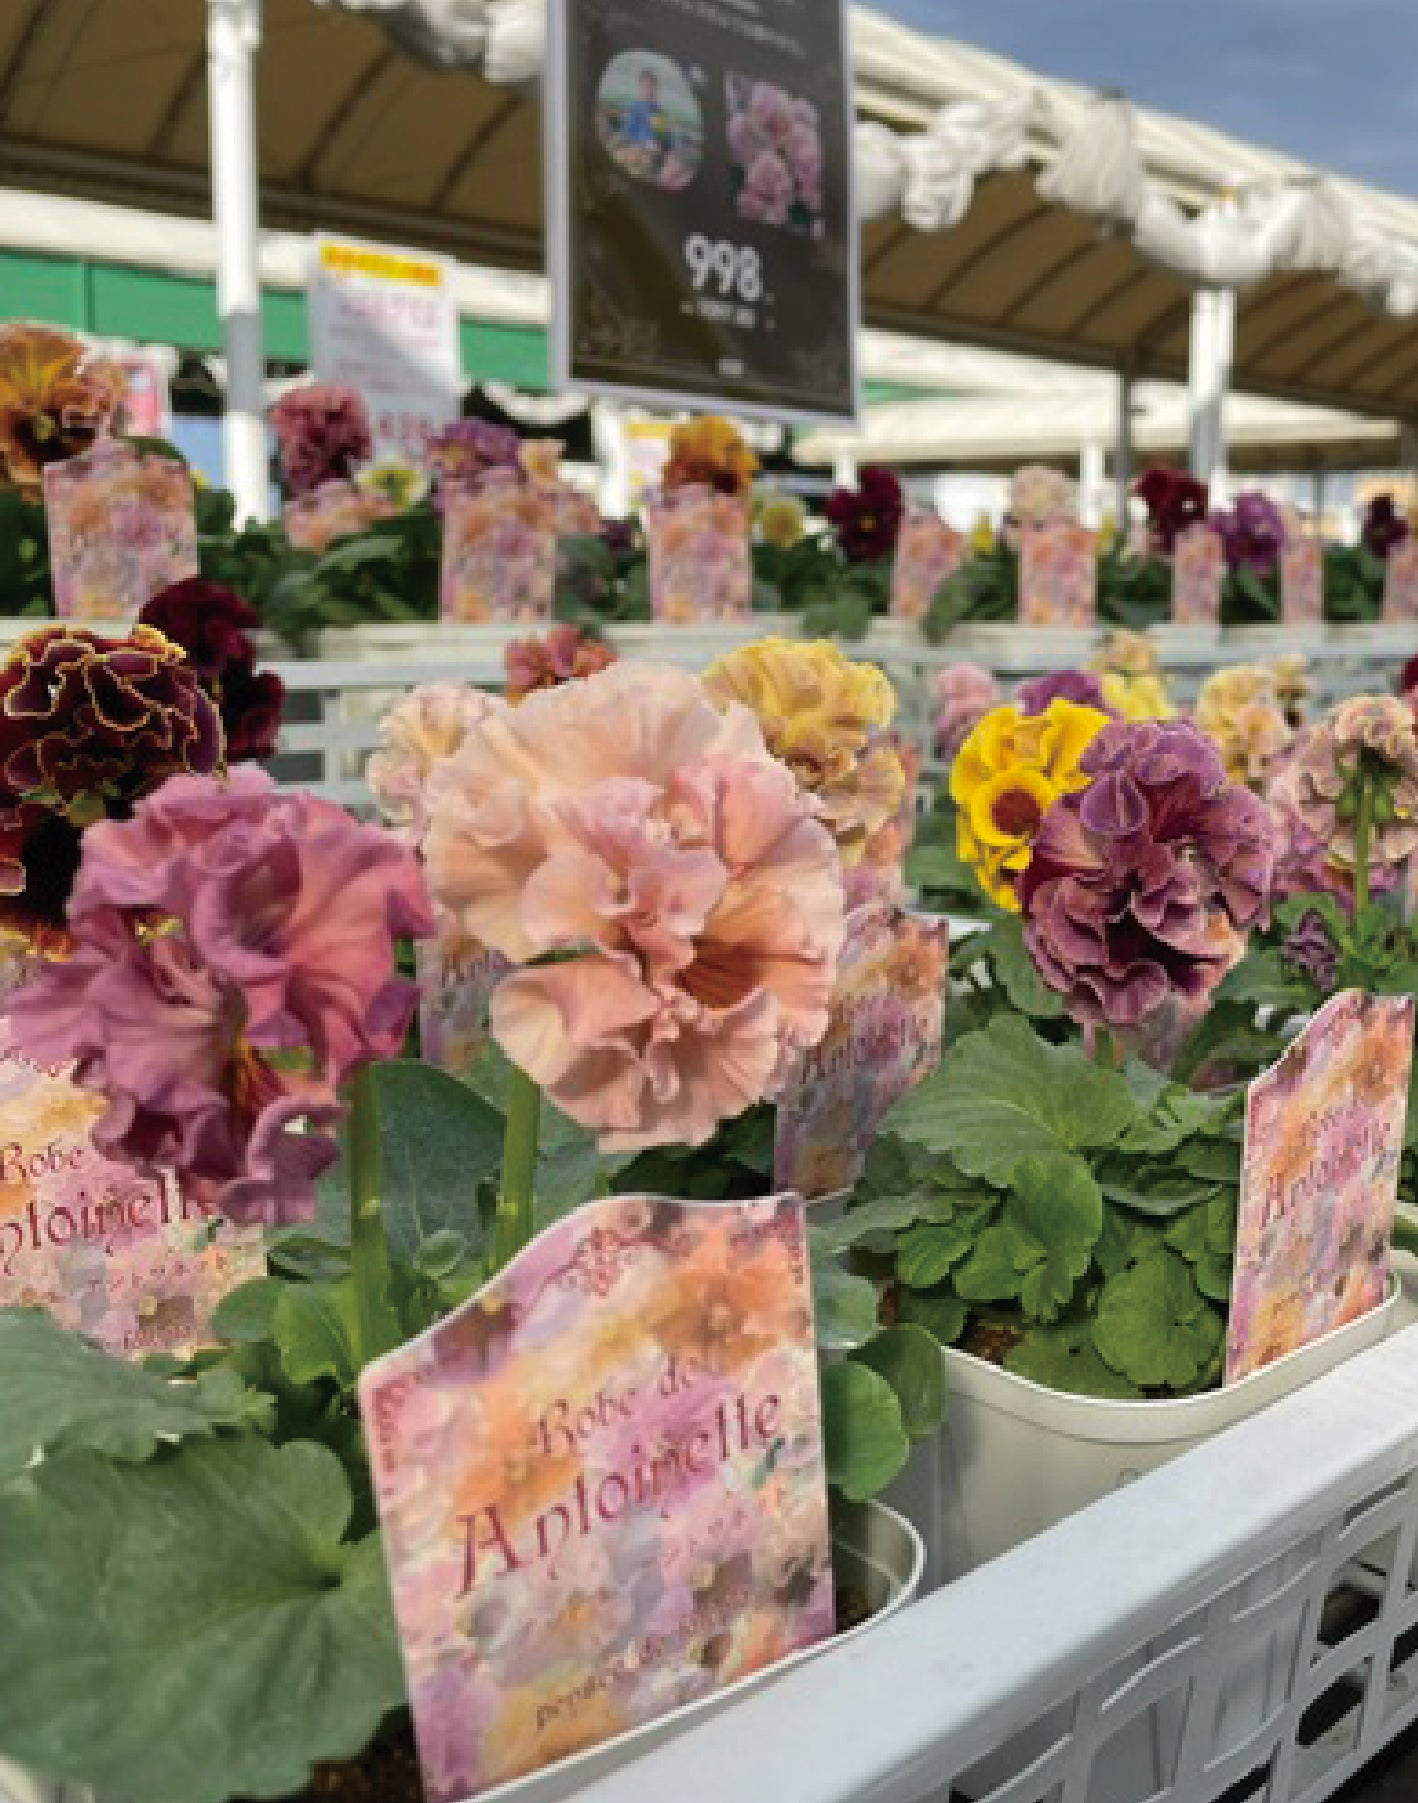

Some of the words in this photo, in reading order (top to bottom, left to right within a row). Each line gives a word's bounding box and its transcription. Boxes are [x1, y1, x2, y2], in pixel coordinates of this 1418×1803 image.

[684, 233, 763, 301] 998
[536, 1386, 639, 1459] Robe
[659, 1354, 703, 1402] de
[453, 1394, 785, 1600] Antoinette
